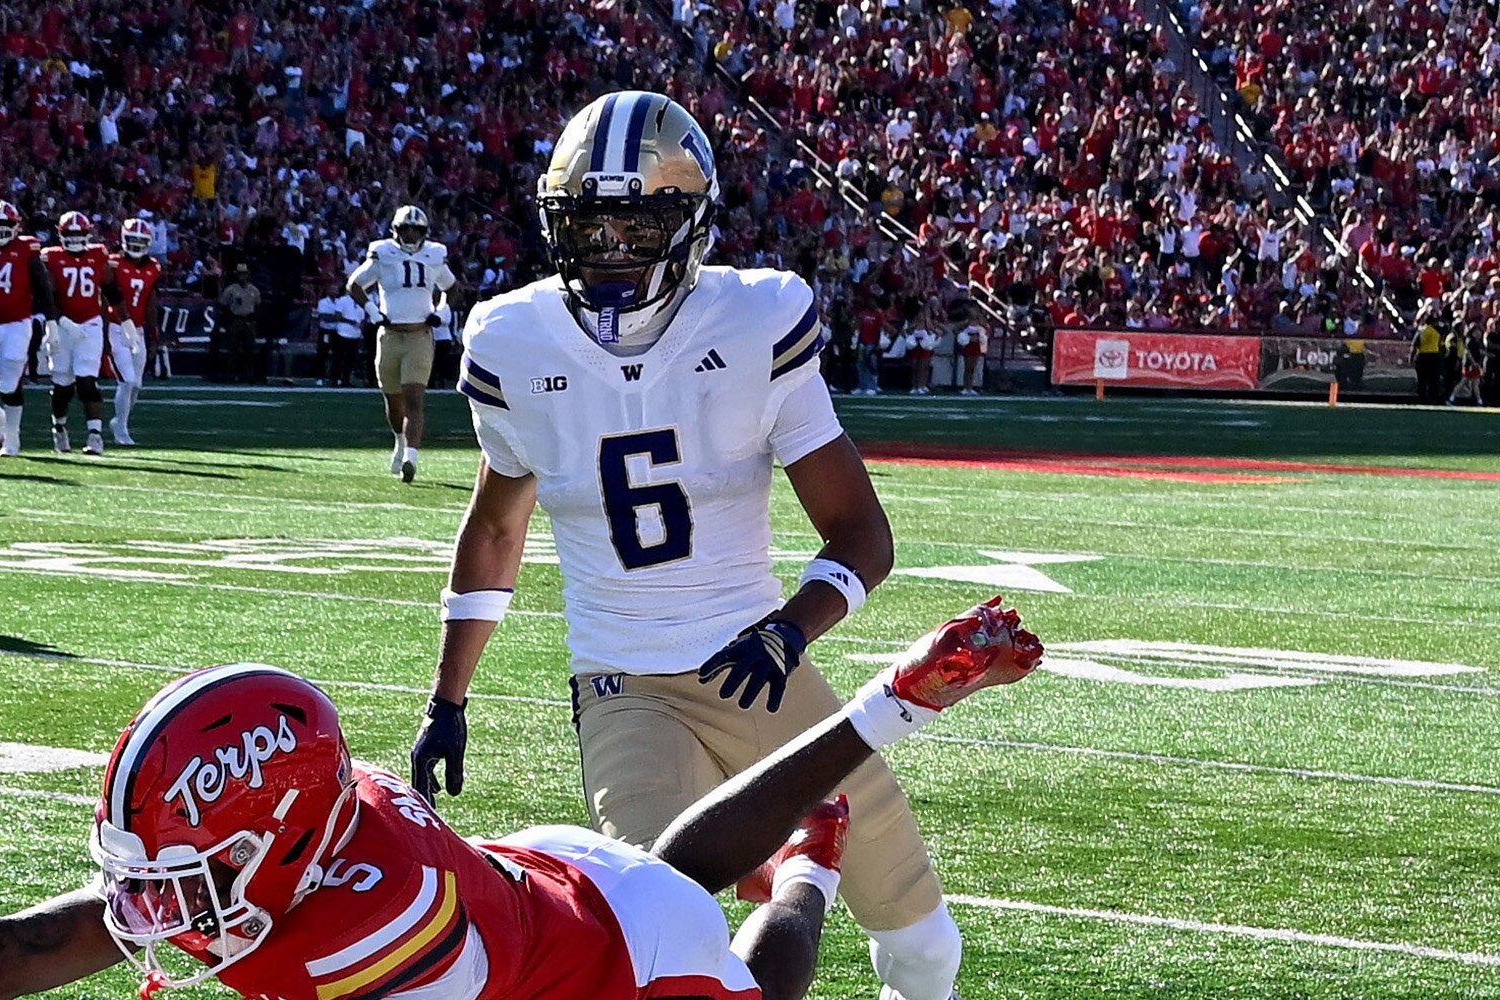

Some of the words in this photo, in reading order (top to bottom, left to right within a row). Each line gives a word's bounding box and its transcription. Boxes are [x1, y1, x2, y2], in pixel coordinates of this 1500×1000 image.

[62, 266, 95, 298] 76
[402, 259, 427, 288] 11
[130, 278, 145, 307] 7
[621, 363, 644, 382] W
[1135, 349, 1218, 371] TOYOTA
[596, 425, 695, 574] 6
[589, 674, 624, 700] W
[163, 713, 298, 828] Terps
[321, 857, 384, 893] 5
